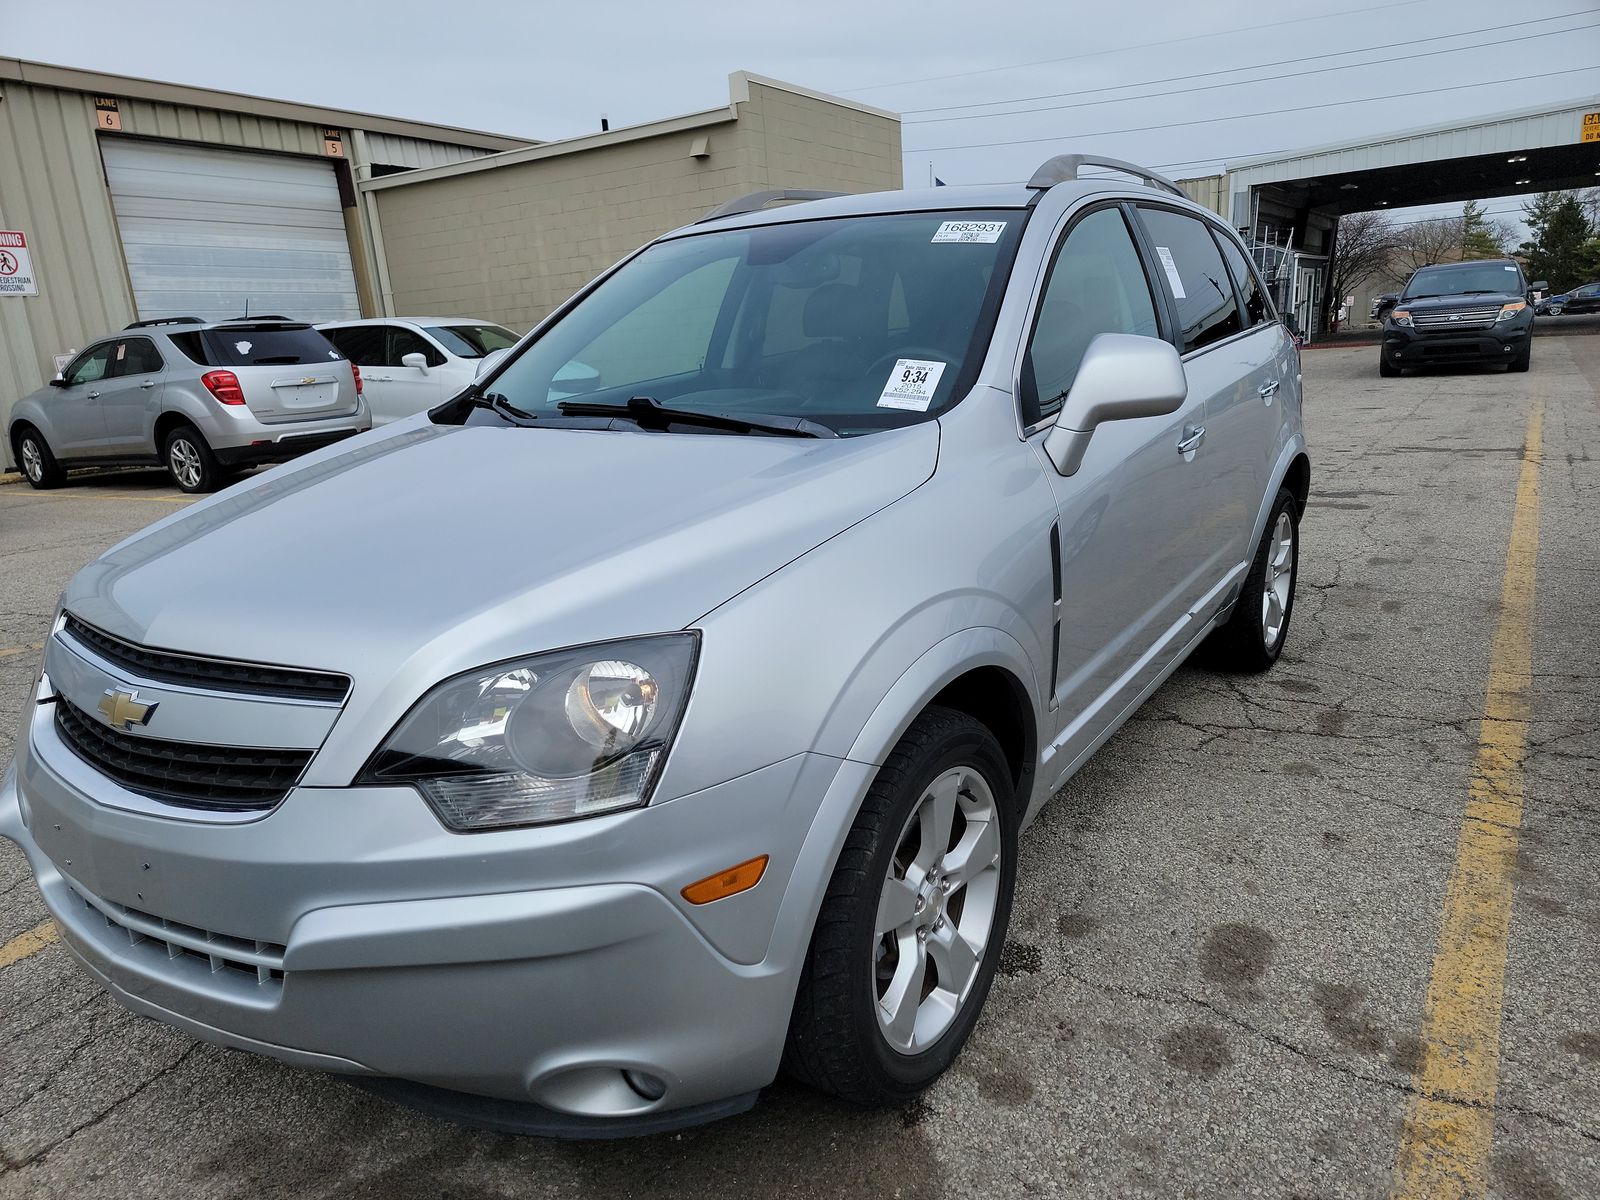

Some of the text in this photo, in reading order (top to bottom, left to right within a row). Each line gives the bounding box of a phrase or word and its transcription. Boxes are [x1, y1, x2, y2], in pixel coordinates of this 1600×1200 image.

[95, 97, 117, 107] LANE
[106, 114, 113, 125] 6
[1585, 113, 1600, 125] CA
[324, 129, 341, 138] LANE
[331, 143, 338, 154] 5
[944, 223, 1004, 232] 1682931
[901, 369, 929, 384] 9:34
